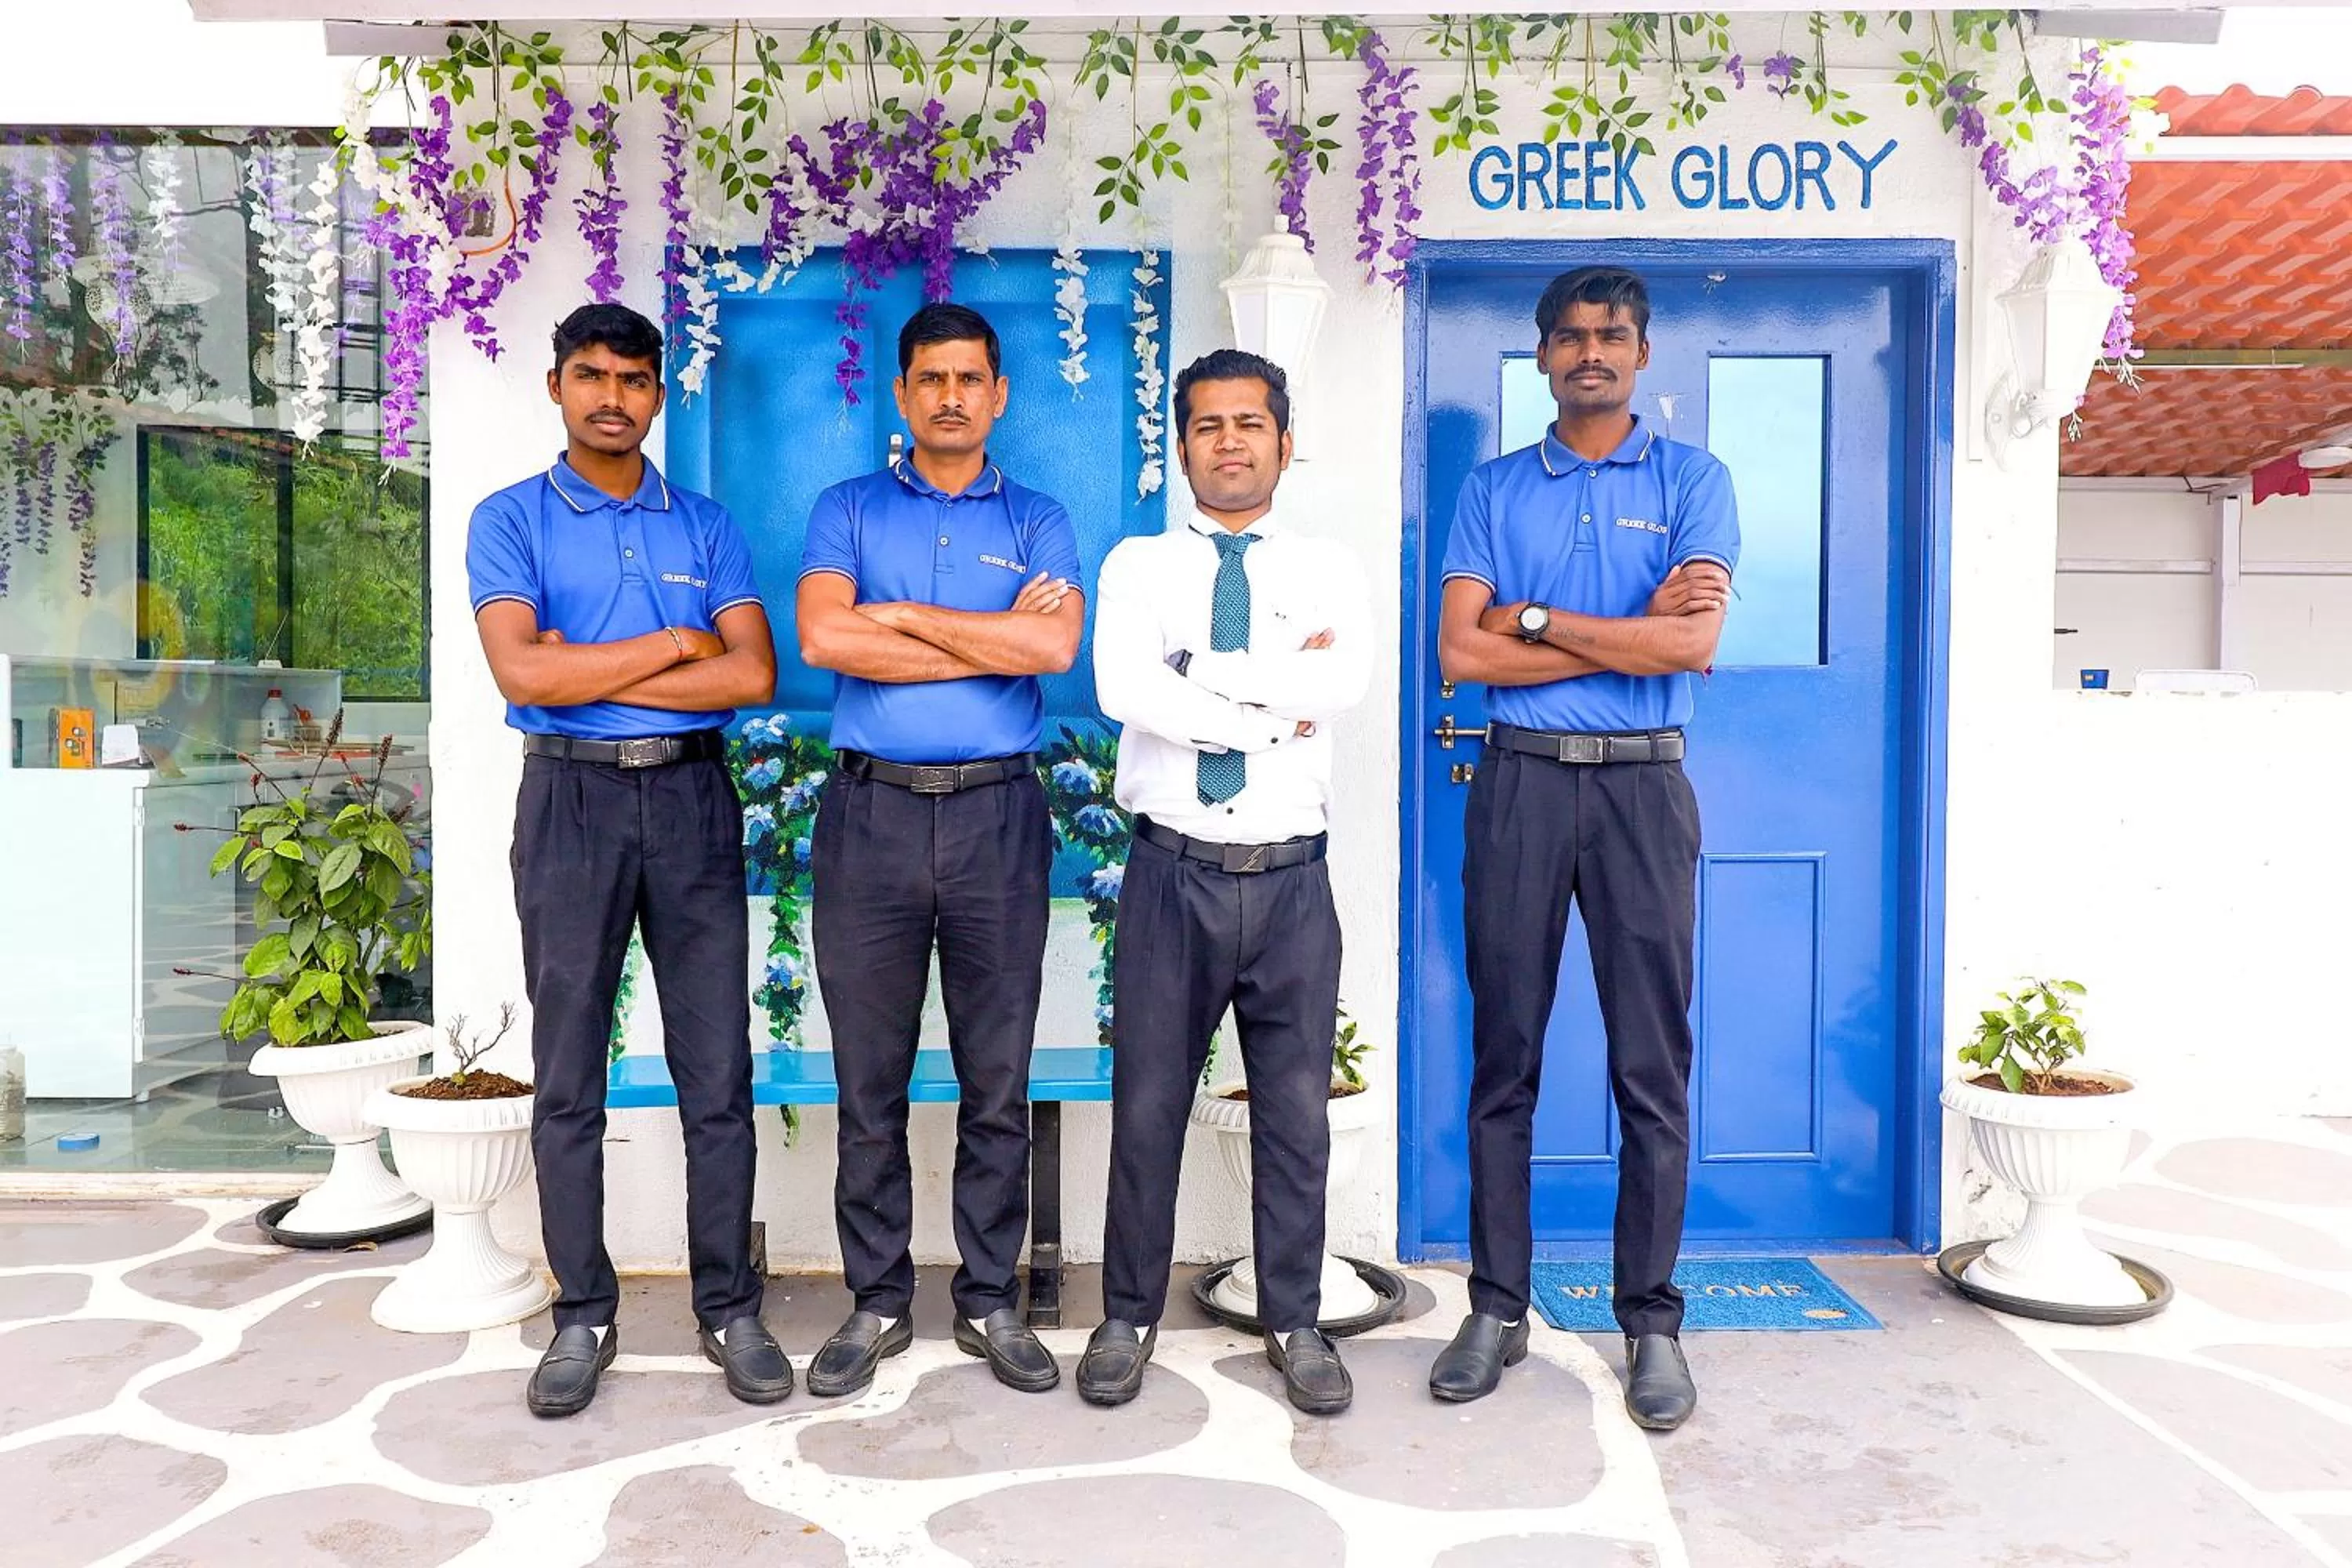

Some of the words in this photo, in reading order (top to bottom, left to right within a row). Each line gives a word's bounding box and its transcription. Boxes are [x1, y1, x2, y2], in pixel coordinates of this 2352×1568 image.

[1468, 141, 1646, 211] GREEK
[1671, 139, 1899, 211] GLORY
[1559, 1282, 1809, 1299] WCOME
